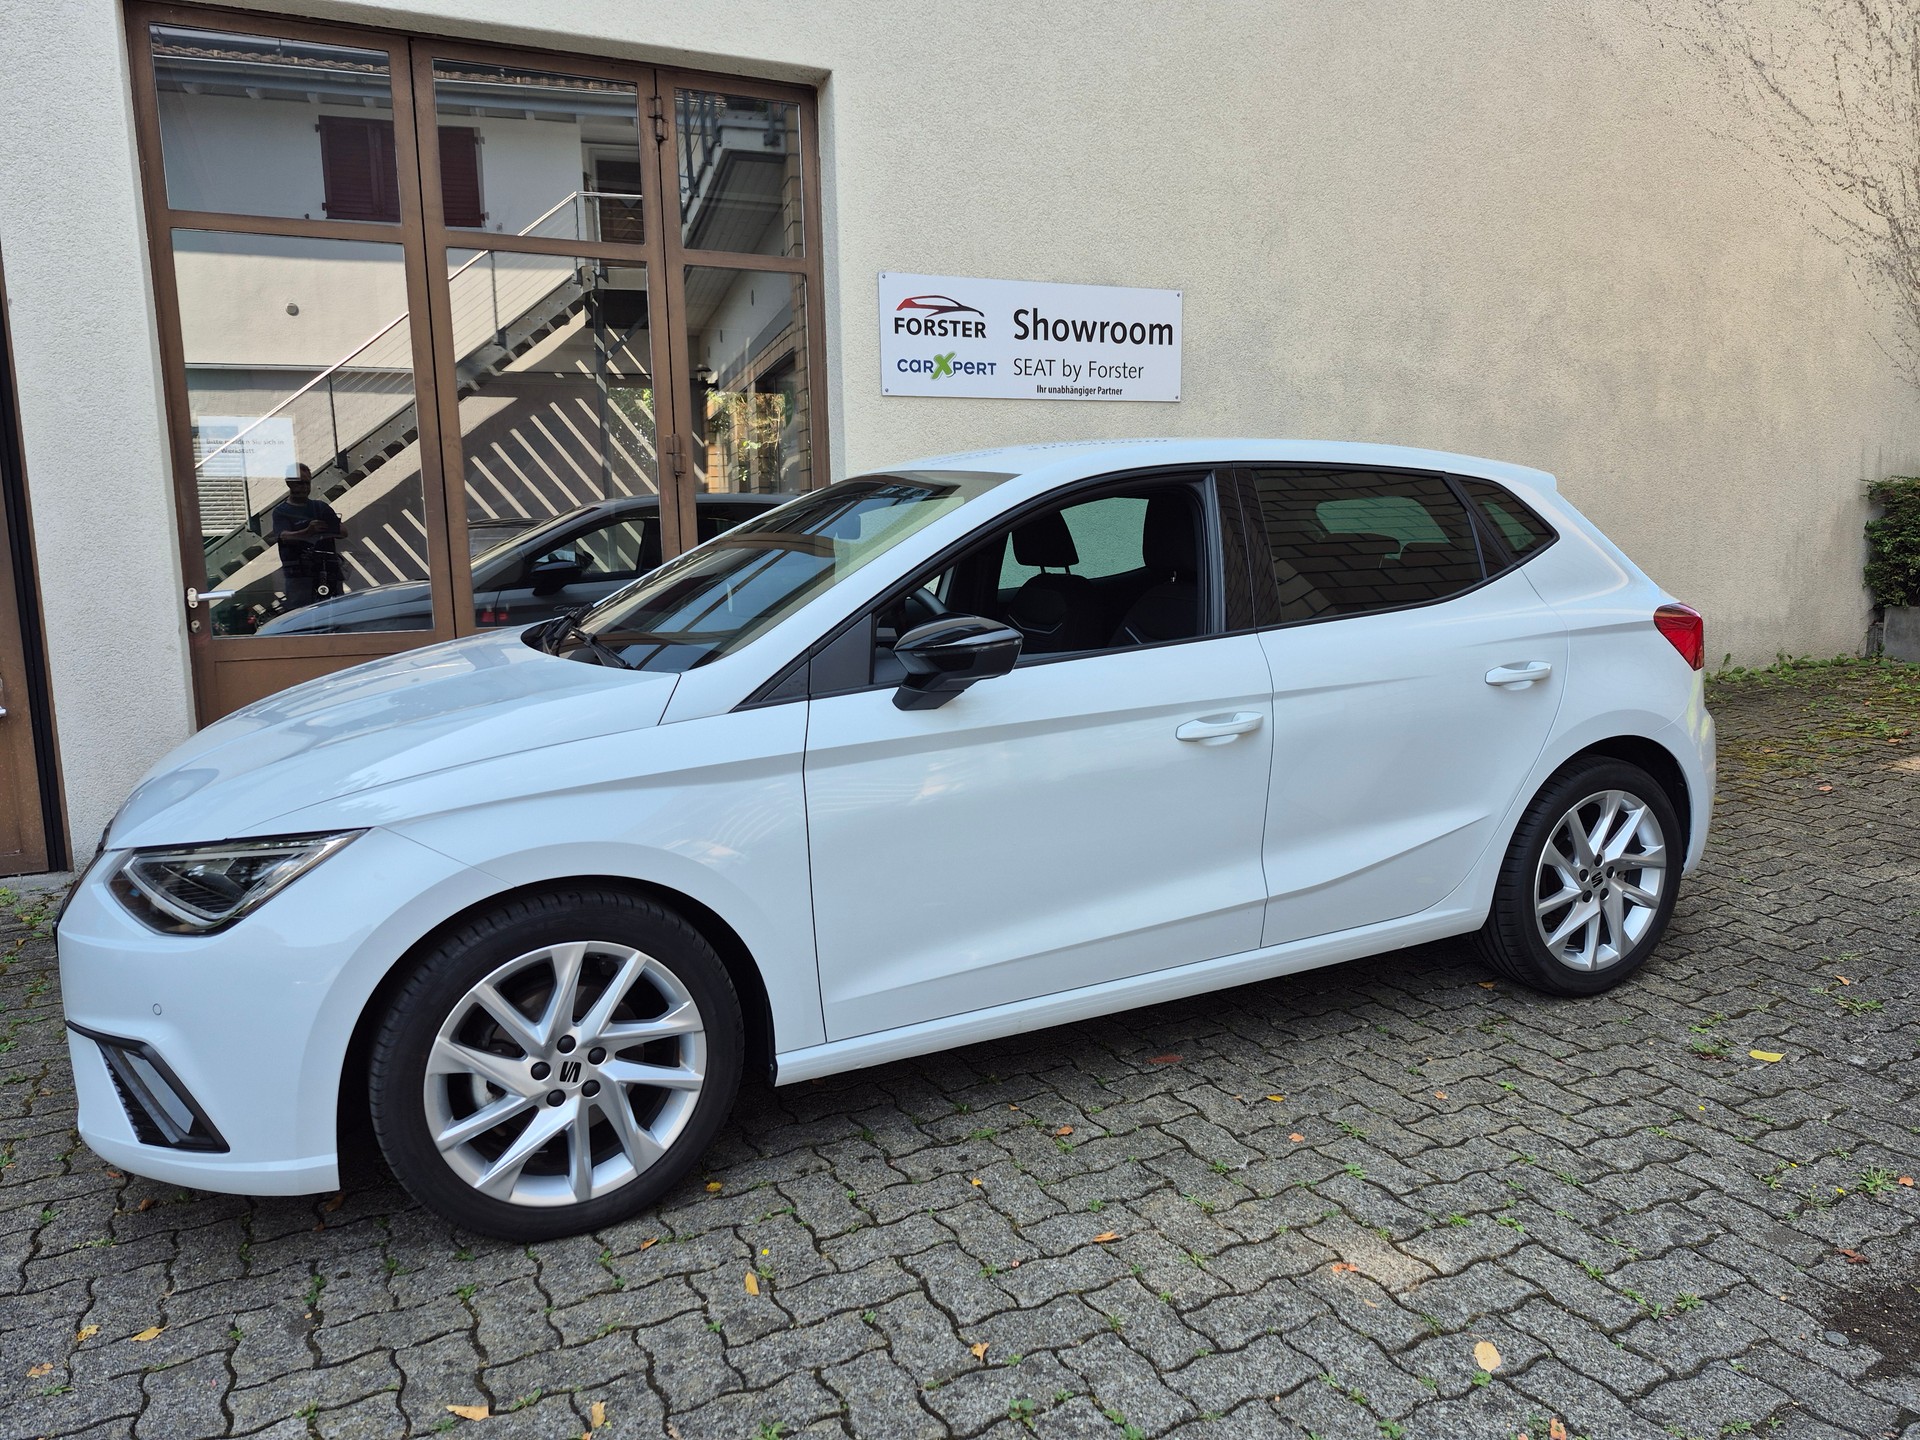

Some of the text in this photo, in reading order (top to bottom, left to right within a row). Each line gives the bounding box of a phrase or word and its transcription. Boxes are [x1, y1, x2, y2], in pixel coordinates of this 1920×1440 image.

[894, 317, 987, 339] FORSTER
[1013, 307, 1173, 346] Showroom
[1013, 358, 1144, 382] SEAT by Forster
[1036, 384, 1123, 397] Ihr unabhängiger Partner
